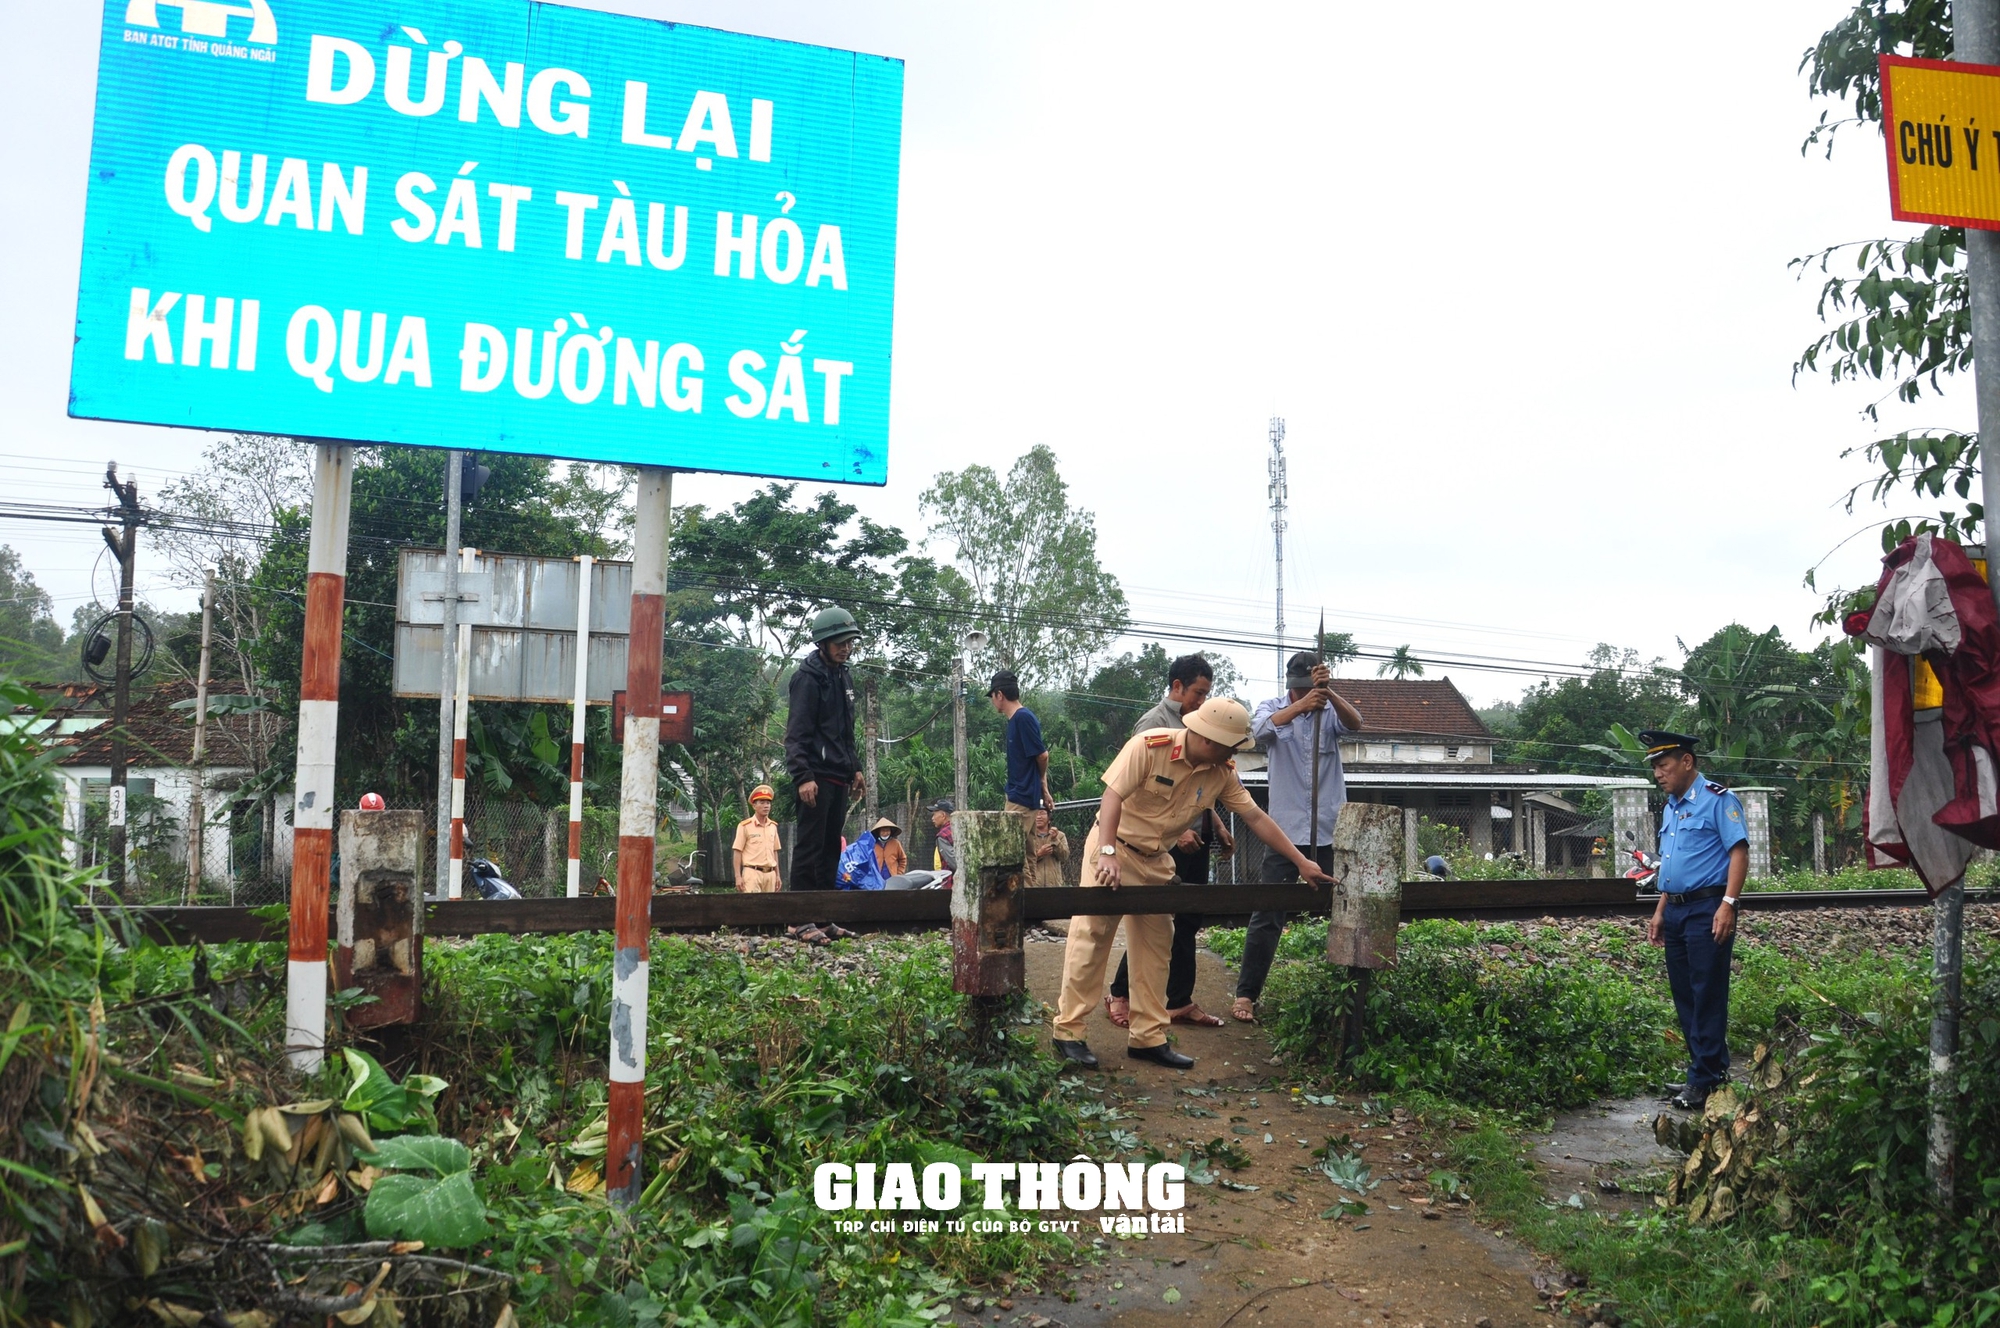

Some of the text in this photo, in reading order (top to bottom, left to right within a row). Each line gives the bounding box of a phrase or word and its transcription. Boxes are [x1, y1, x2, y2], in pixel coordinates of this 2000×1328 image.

[123, 29, 148, 44] BAN
[150, 34, 180, 49] ATGT
[210, 41, 248, 58] QUẢNG
[305, 26, 774, 171] DỪNG LẠI
[1900, 114, 1953, 168] CHÚ
[1963, 117, 1980, 171] Ý
[164, 143, 848, 291] QUAN SÁT TÀU HỎA
[124, 287, 854, 425] KHI QUA ĐƯỜNG SẮT
